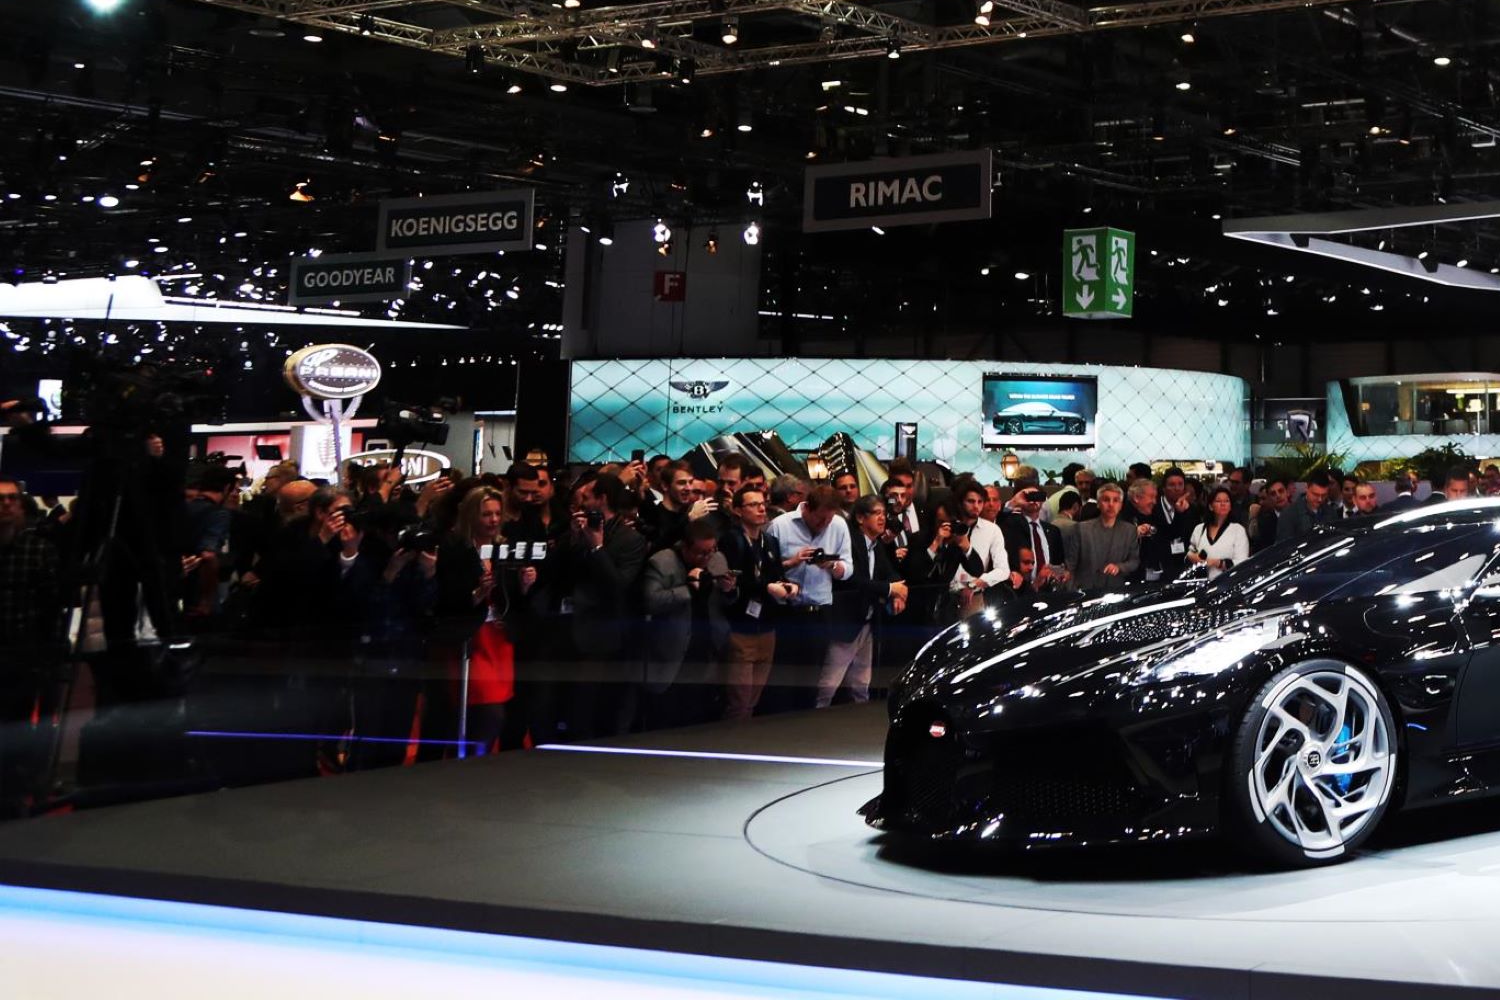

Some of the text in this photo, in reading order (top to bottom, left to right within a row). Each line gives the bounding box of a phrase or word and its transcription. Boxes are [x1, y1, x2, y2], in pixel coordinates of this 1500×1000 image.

[850, 175, 943, 208] RIMAC
[390, 210, 519, 238] KOENIGSEGG
[303, 267, 396, 288] GOODYEAR
[663, 273, 681, 295] F
[672, 405, 724, 414] BENTLEY
